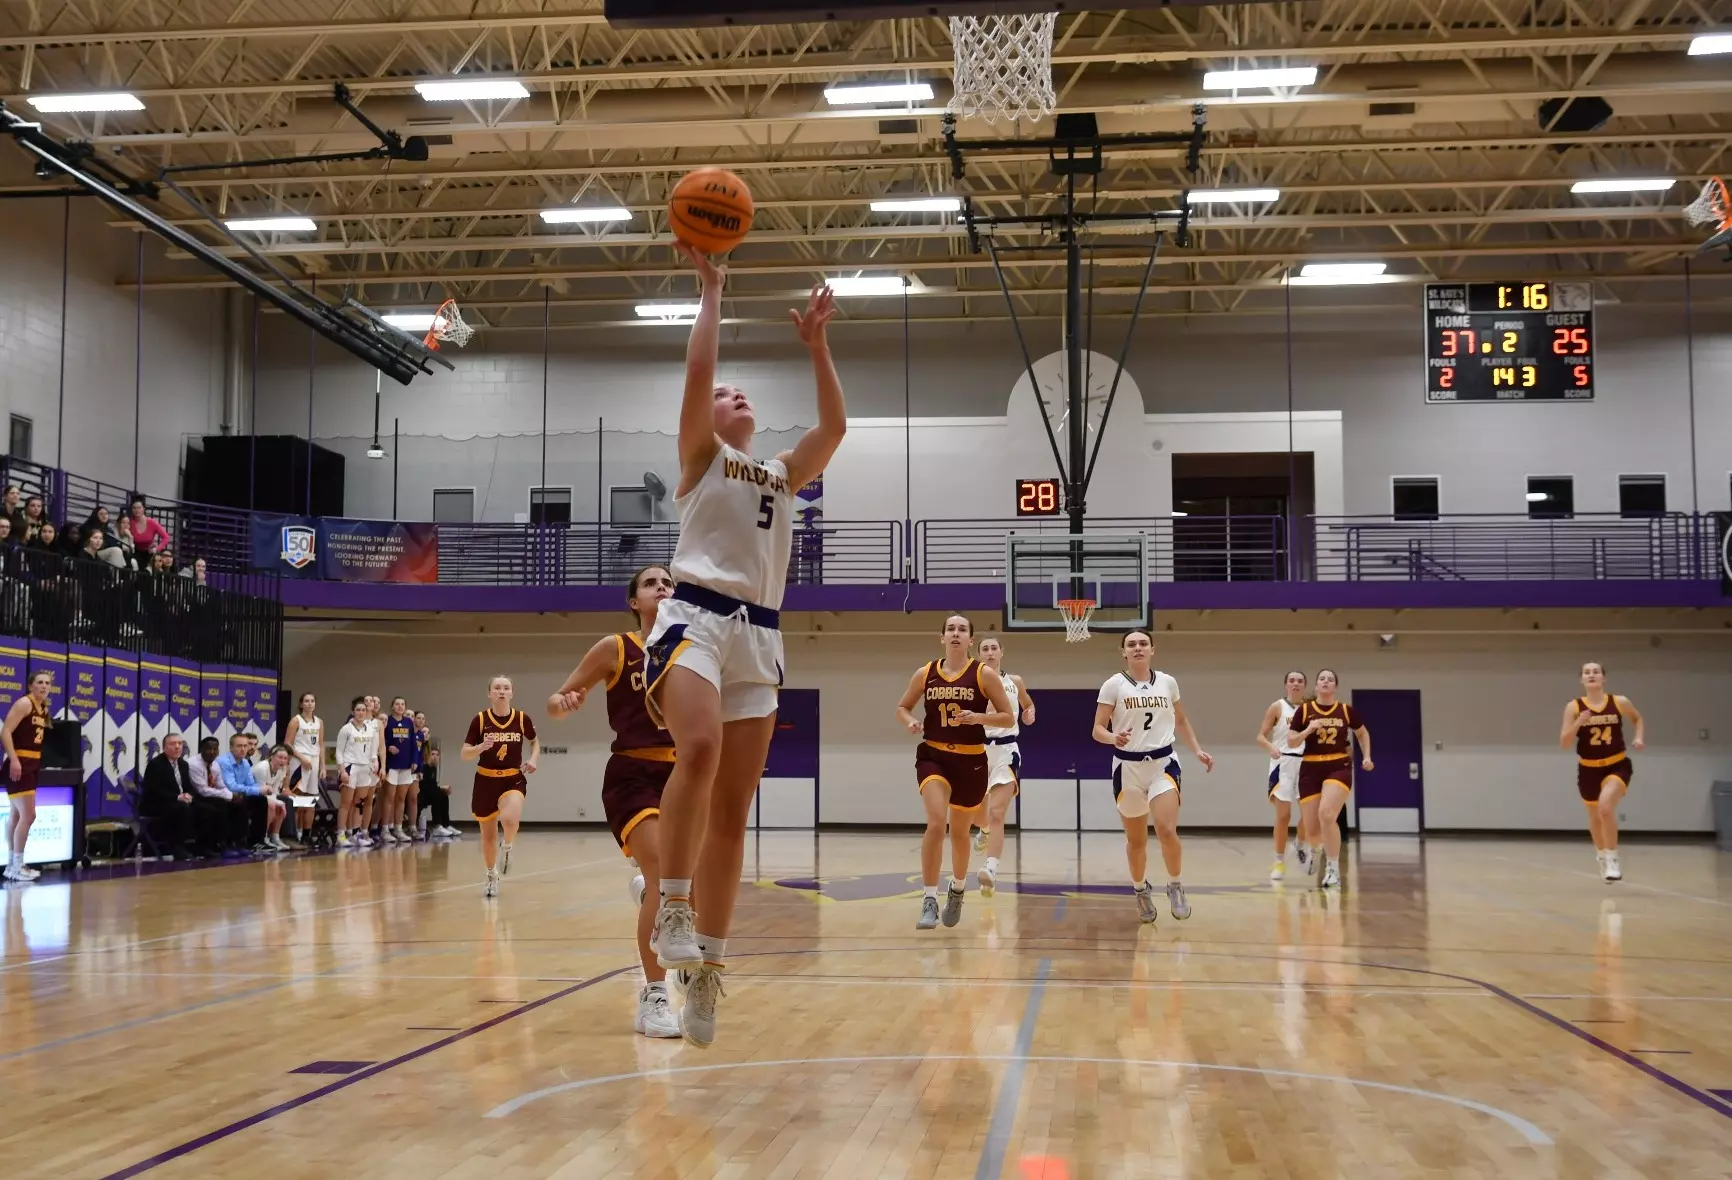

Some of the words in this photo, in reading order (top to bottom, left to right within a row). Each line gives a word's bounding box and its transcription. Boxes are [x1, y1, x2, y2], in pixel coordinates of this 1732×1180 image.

[687, 204, 741, 232] Wilson
[1498, 283, 1548, 309] 1:16
[1435, 315, 1471, 328] HOME
[1494, 321, 1524, 330] PERIOD
[1546, 313, 1585, 326] GUEST
[1441, 330, 1475, 356] 37
[1502, 331, 1518, 353] 2
[1553, 328, 1589, 354] 25
[1430, 358, 1457, 367] FOULS
[1481, 358, 1512, 366] PLAYER
[1517, 357, 1538, 366] FOUL
[1564, 356, 1591, 365] FOULS
[1439, 368, 1454, 387] 2
[1493, 367, 1514, 386] 14
[1522, 366, 1536, 387] 3
[1573, 365, 1588, 386] 5
[1430, 391, 1457, 399] SCORE
[1497, 390, 1524, 398] MATCH
[1564, 389, 1591, 398] SCORE
[1020, 483, 1054, 511] 28
[757, 495, 775, 530] 5
[289, 536, 309, 551] 50
[329, 533, 372, 542] CELEBRATING
[327, 542, 363, 551] HONORING
[334, 552, 364, 560] LOOKING
[114, 675, 128, 686] NCAA
[926, 686, 975, 701] COBBERS
[1123, 696, 1169, 710] WILDCATS
[938, 702, 962, 728] 13
[1143, 712, 1153, 731] 2
[1316, 727, 1338, 745] 32
[1590, 726, 1613, 746] 24
[496, 744, 508, 761] 4
